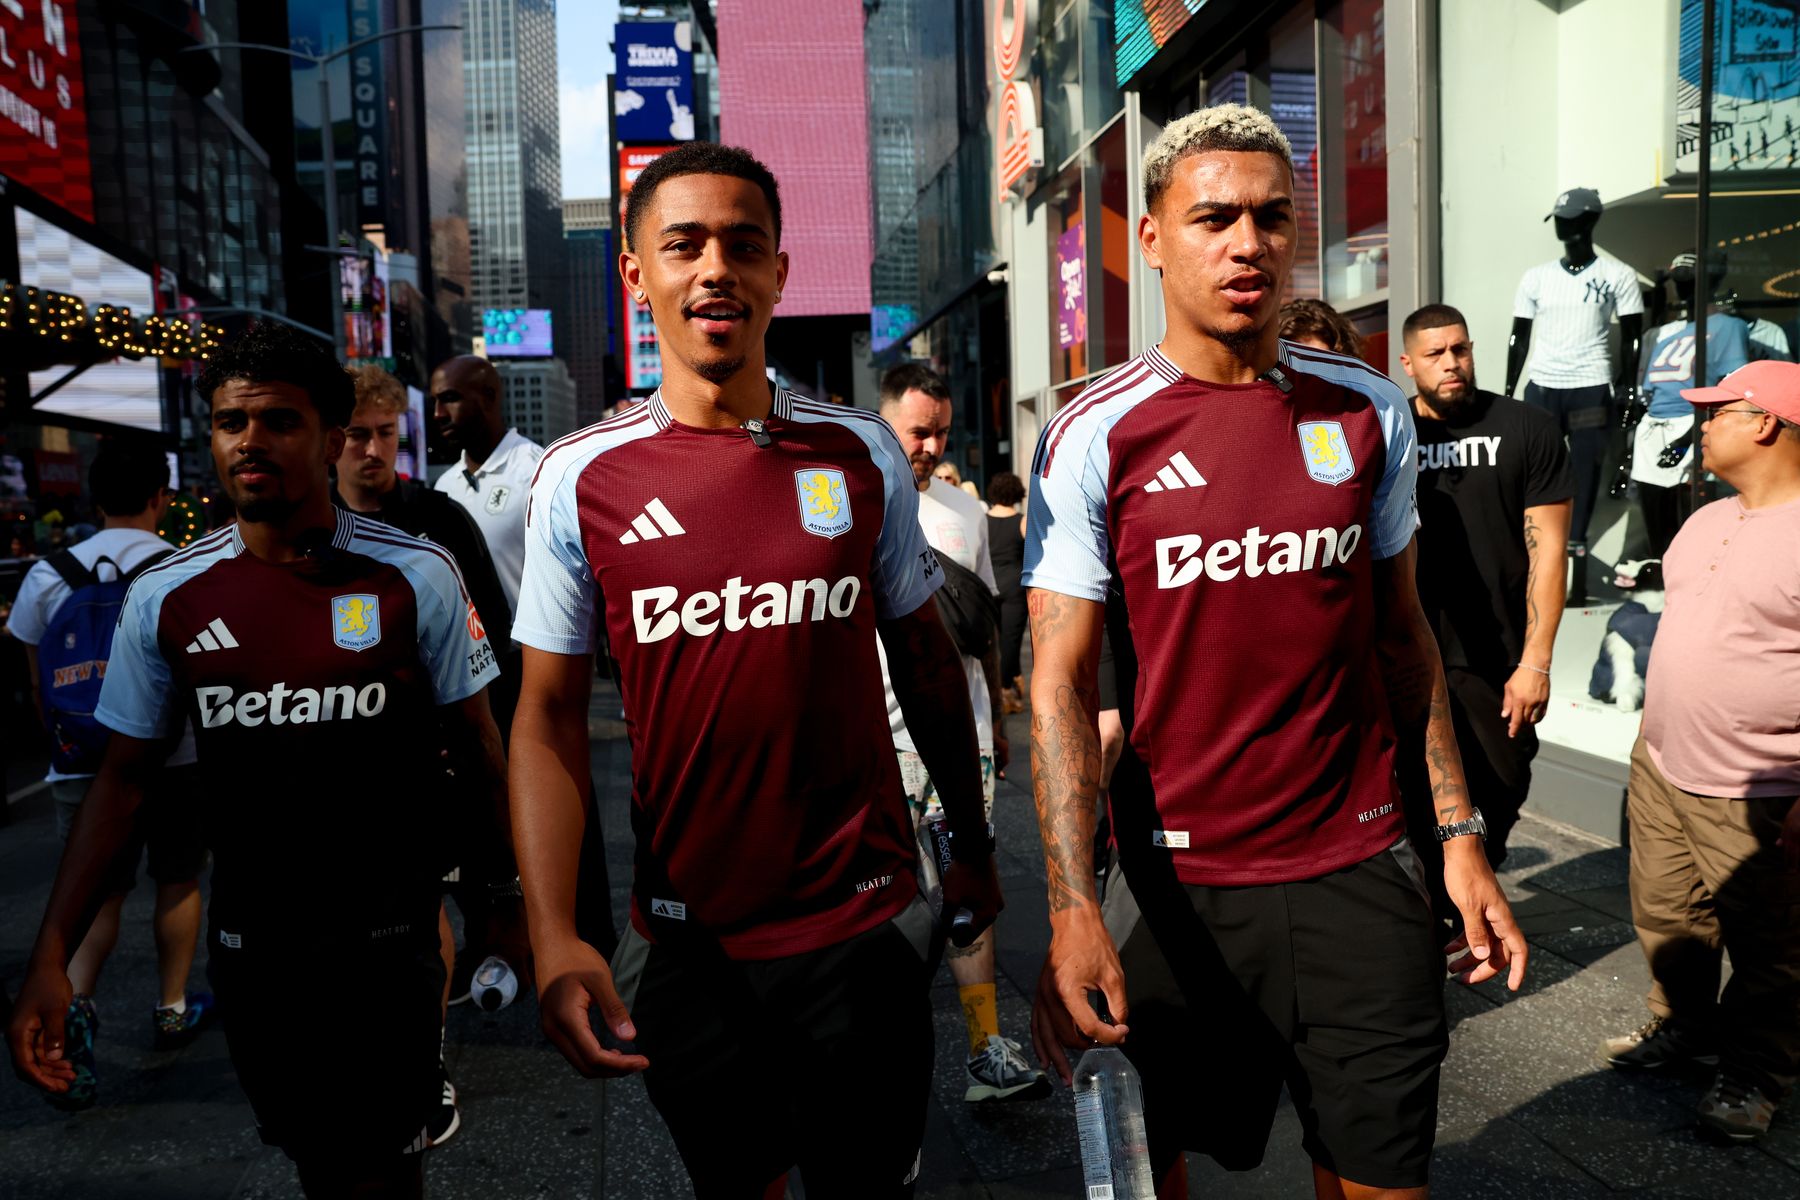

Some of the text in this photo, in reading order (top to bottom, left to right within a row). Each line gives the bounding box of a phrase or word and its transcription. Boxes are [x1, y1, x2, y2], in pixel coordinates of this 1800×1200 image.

[627, 46, 677, 59] TRIVIA
[355, 56, 378, 207] SQUARE
[1313, 468, 1351, 480] ASTON VILLA
[808, 521, 849, 533] ASTON VILLA
[1156, 524, 1362, 590] Betano
[631, 575, 861, 644] Betano
[339, 636, 377, 647] ASTON VILLA
[53, 660, 94, 689] NEW
[195, 681, 386, 729] Betano
[1358, 802, 1393, 823] HEAT.RDY
